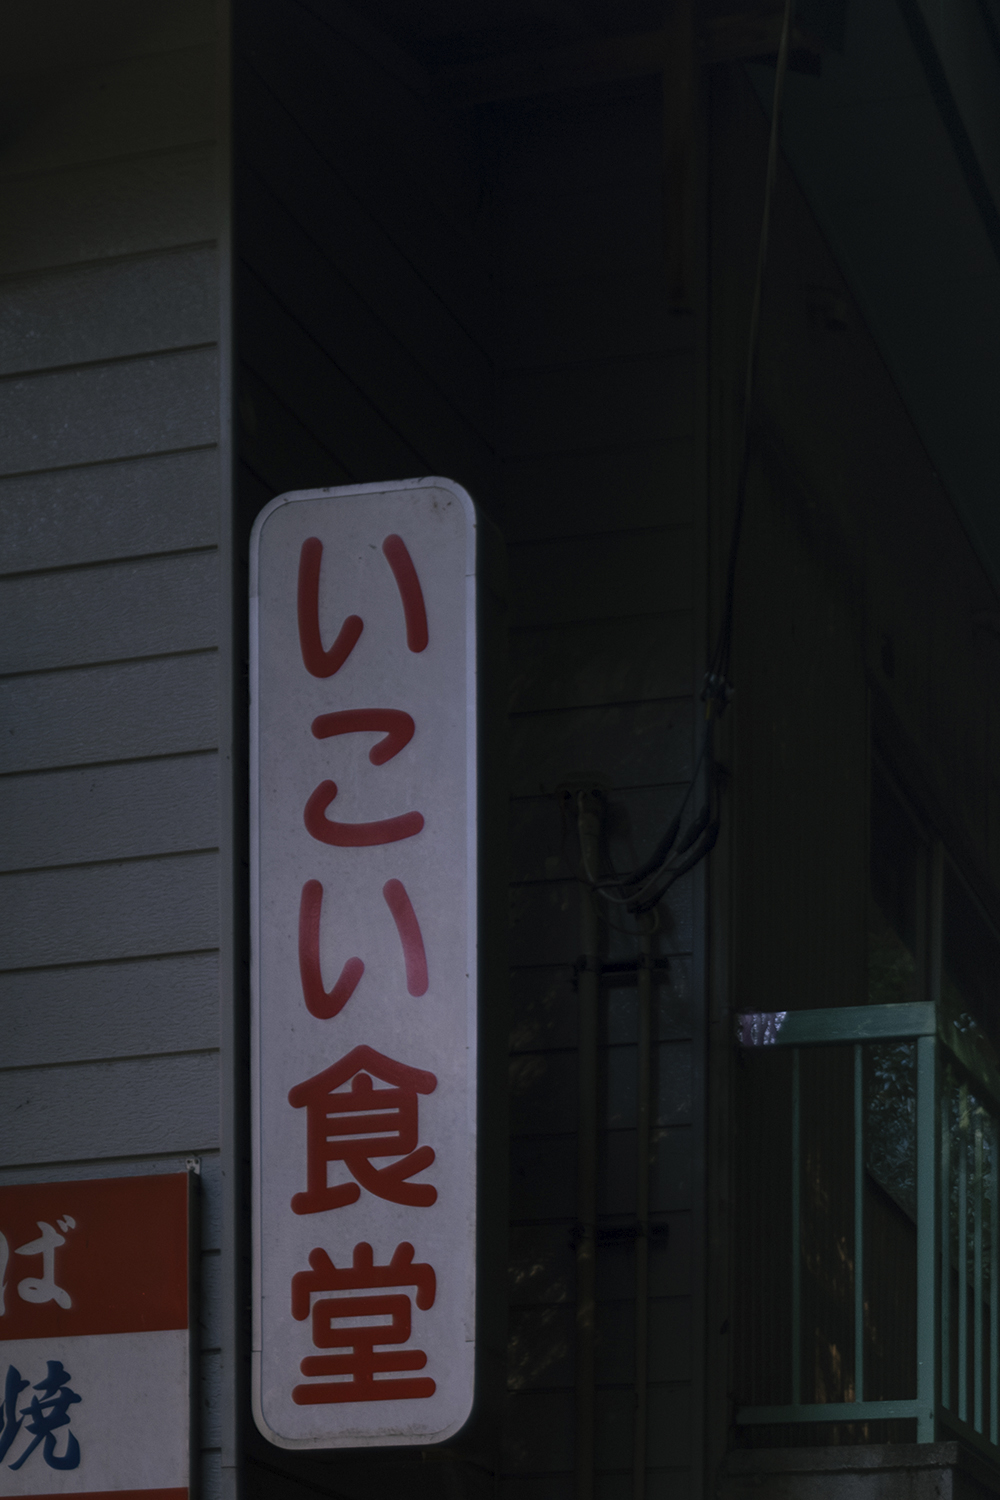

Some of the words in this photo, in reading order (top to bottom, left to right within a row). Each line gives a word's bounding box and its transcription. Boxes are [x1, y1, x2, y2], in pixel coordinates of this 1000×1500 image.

[286, 533, 438, 1406] いこい食堂
